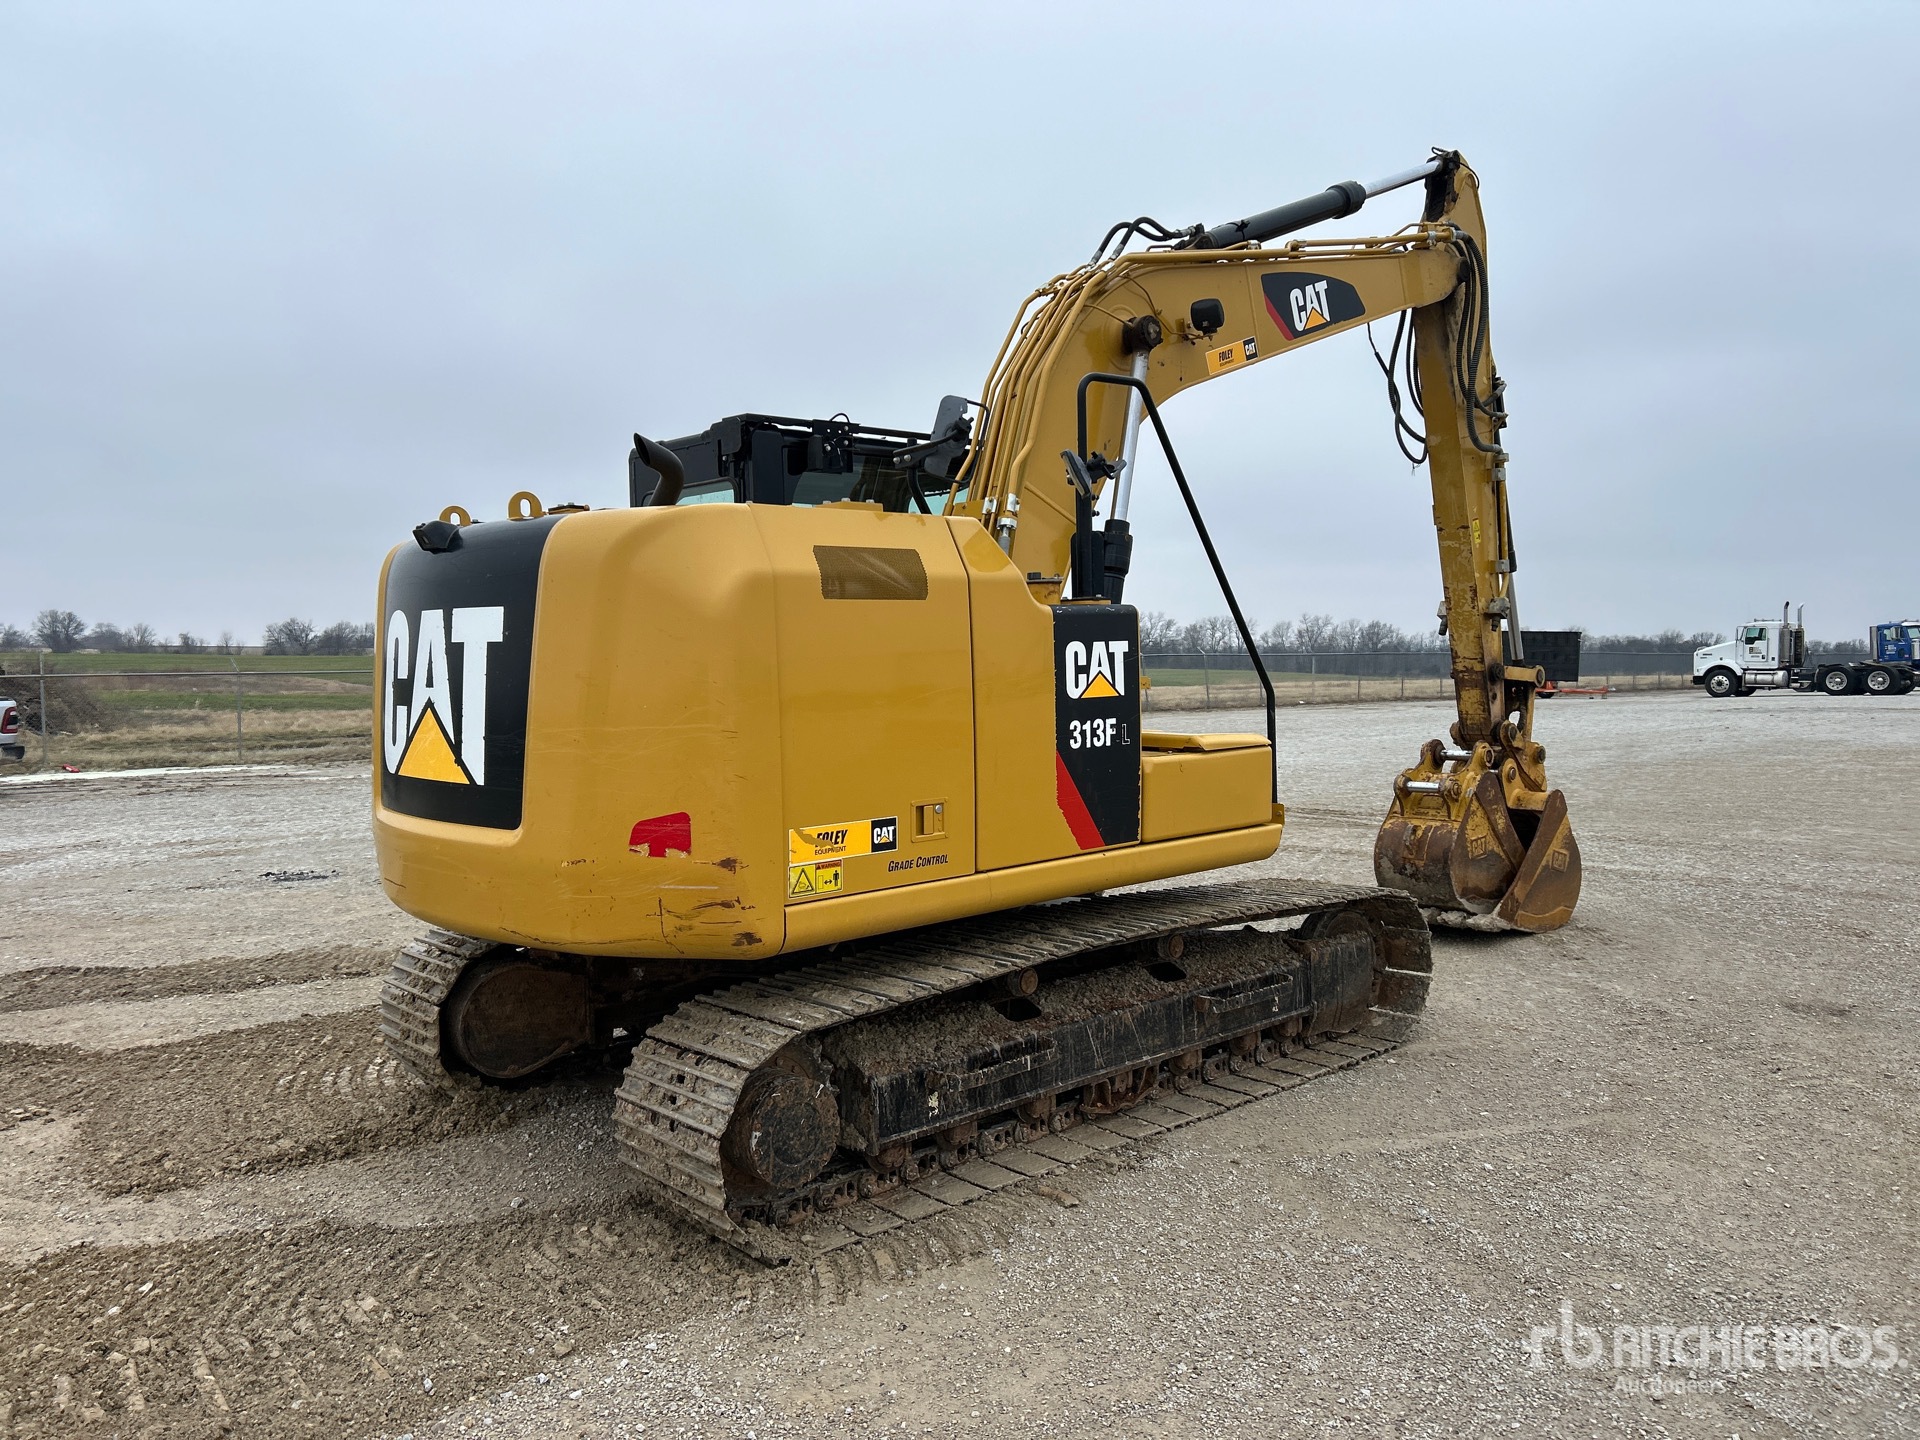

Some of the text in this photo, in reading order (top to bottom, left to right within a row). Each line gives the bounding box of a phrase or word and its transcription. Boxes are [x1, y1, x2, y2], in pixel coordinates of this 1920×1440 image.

[1289, 279, 1331, 332] CAT
[1218, 348, 1234, 362] FOLEY
[1245, 342, 1256, 356] CAT
[1065, 640, 1129, 700] CAT
[383, 605, 504, 786] CAT
[1069, 717, 1117, 749] 313F
[873, 825, 895, 845] CAT
[888, 854, 949, 872] GRADE CONTROL
